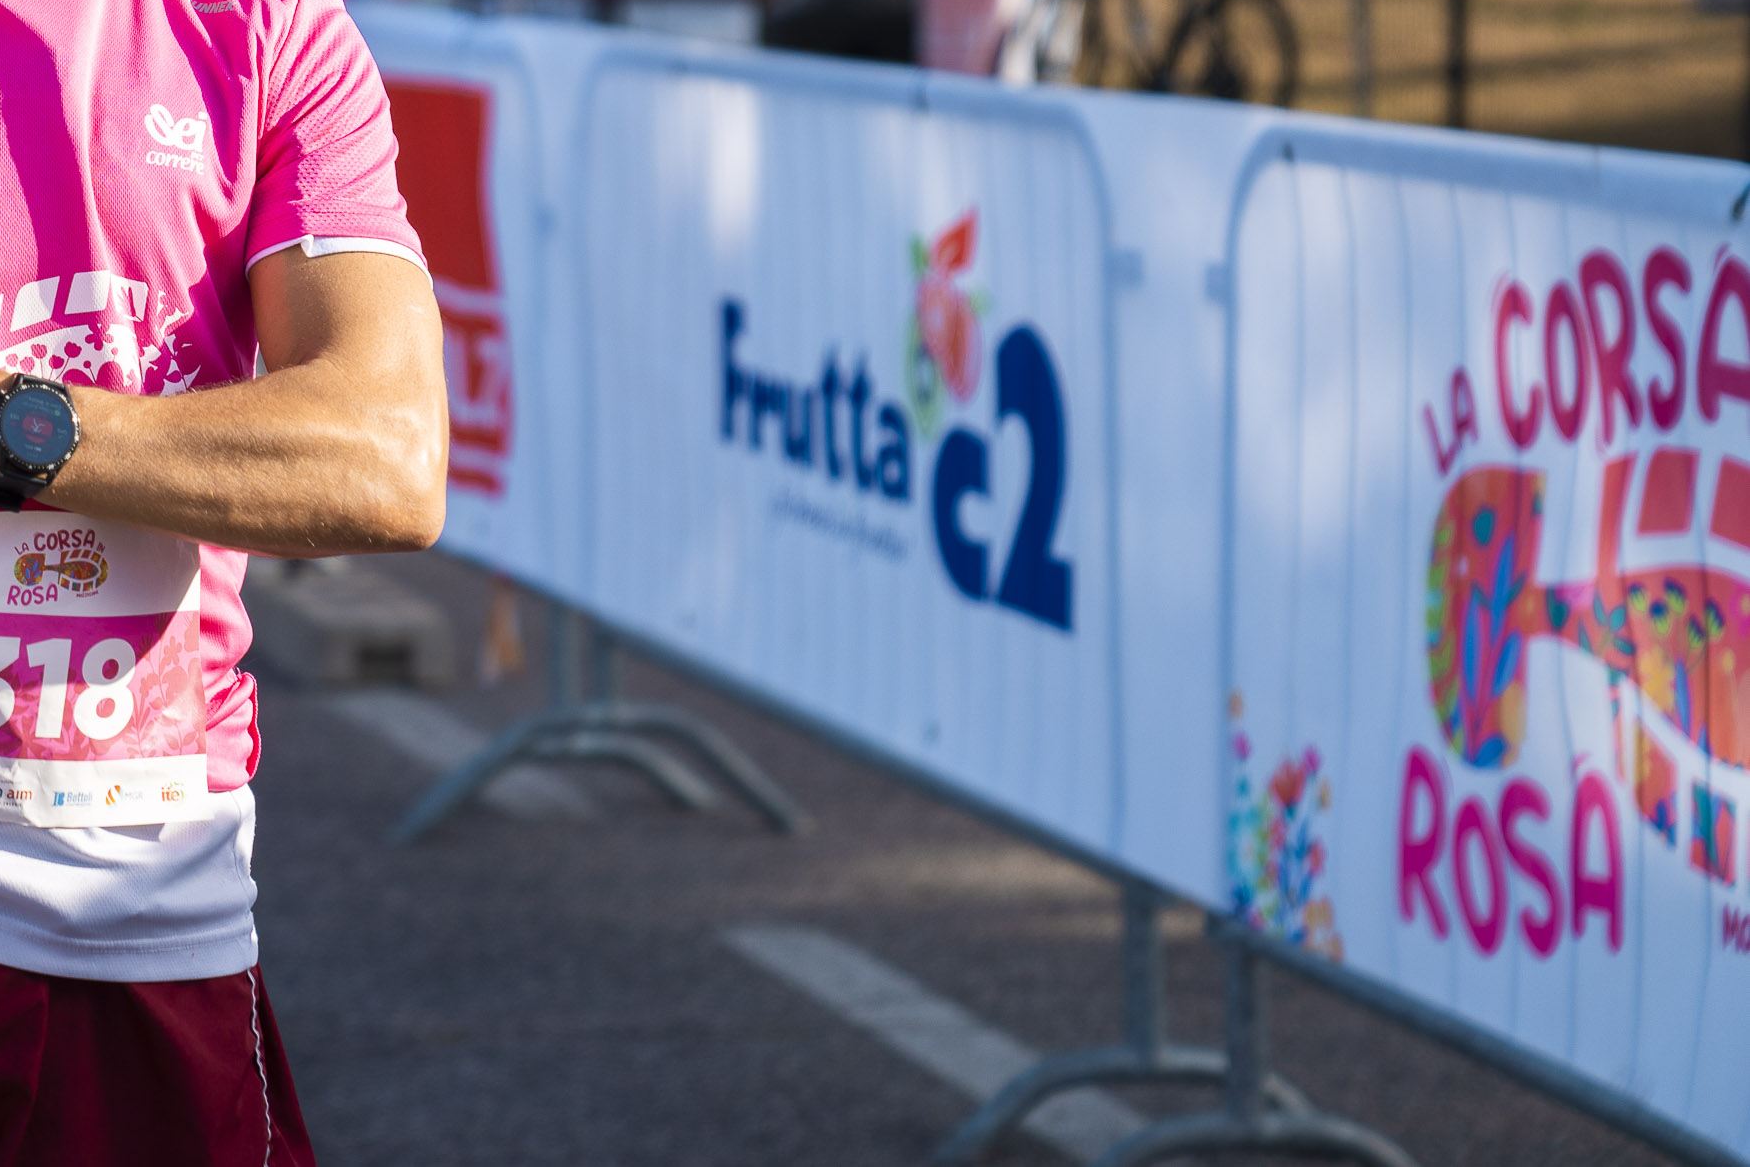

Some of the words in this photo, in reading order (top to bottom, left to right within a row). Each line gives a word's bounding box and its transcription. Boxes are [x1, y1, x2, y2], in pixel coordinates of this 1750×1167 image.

[146, 150, 205, 175] correre
[718, 296, 911, 502] Frutta
[1424, 367, 1479, 476] LA
[14, 542, 29, 555] LA
[34, 528, 96, 551] CORSA
[96, 541, 106, 554] IN
[7, 582, 58, 606] ROSA
[1397, 746, 1625, 959] ROSA
